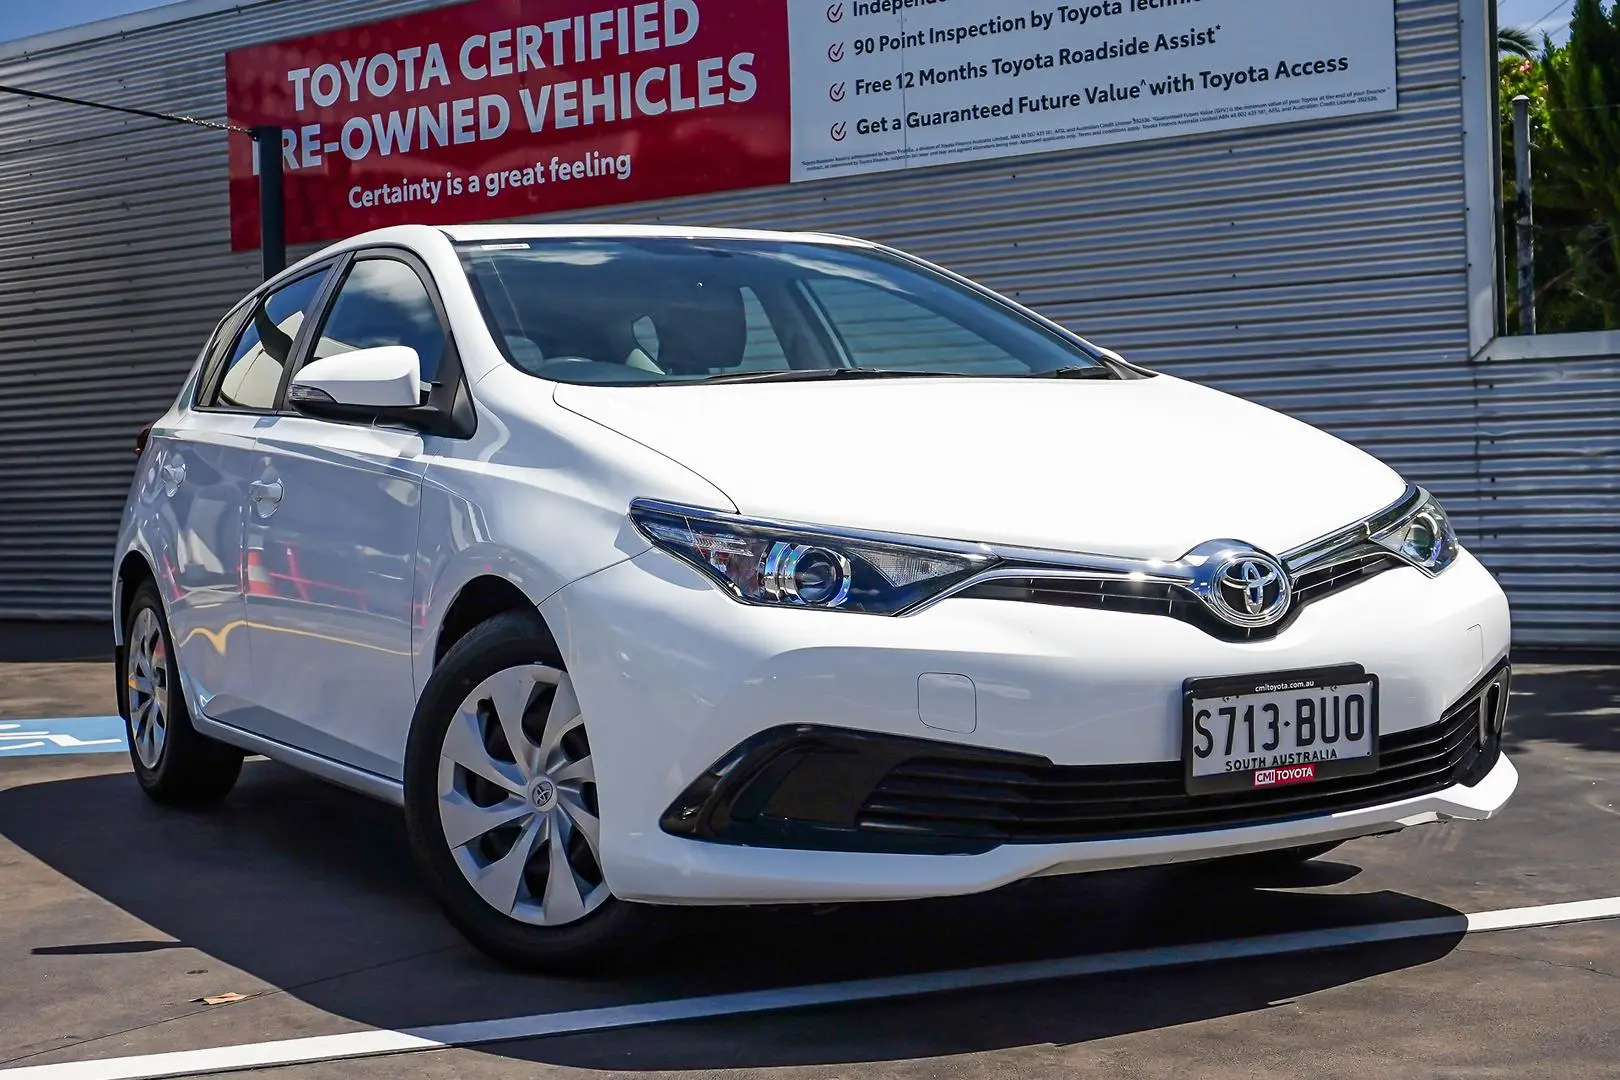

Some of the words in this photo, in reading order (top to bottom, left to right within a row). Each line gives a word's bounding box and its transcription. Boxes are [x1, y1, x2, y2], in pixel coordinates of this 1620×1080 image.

[853, 0, 946, 16] Indepen
[854, 38, 874, 55] 90
[880, 31, 925, 51] Point
[930, 17, 1026, 44] Inspection
[1031, 11, 1053, 31] by
[1058, 0, 1122, 24] Toyota
[288, 42, 450, 112] TOYOTA
[459, 0, 700, 80] CERTIFIED
[855, 78, 891, 98] Free
[896, 73, 914, 90] 12
[919, 64, 987, 86] Months
[992, 53, 1054, 82] Toyota
[1059, 37, 1149, 66] Roadside
[252, 94, 511, 176] RE-OWNED
[518, 52, 758, 133] VEHICLES
[857, 115, 888, 135] Get
[893, 118, 902, 131] a
[906, 96, 1013, 128] Guaranteed
[1018, 87, 1079, 110] Future
[1149, 72, 1195, 96] with
[1199, 62, 1270, 92] Toyota
[1274, 53, 1349, 80] Access
[348, 175, 442, 210] Certainty
[446, 171, 463, 197] is
[468, 177, 480, 193] a
[485, 163, 546, 196] great
[550, 151, 632, 181] feeling
[1254, 680, 1314, 692] cmitoyota.com.au
[1225, 756, 1266, 772] SOUTH
[1272, 748, 1338, 766] AUSTRALIA
[1256, 770, 1275, 784] CMI
[1276, 767, 1314, 782] TOYOTA
